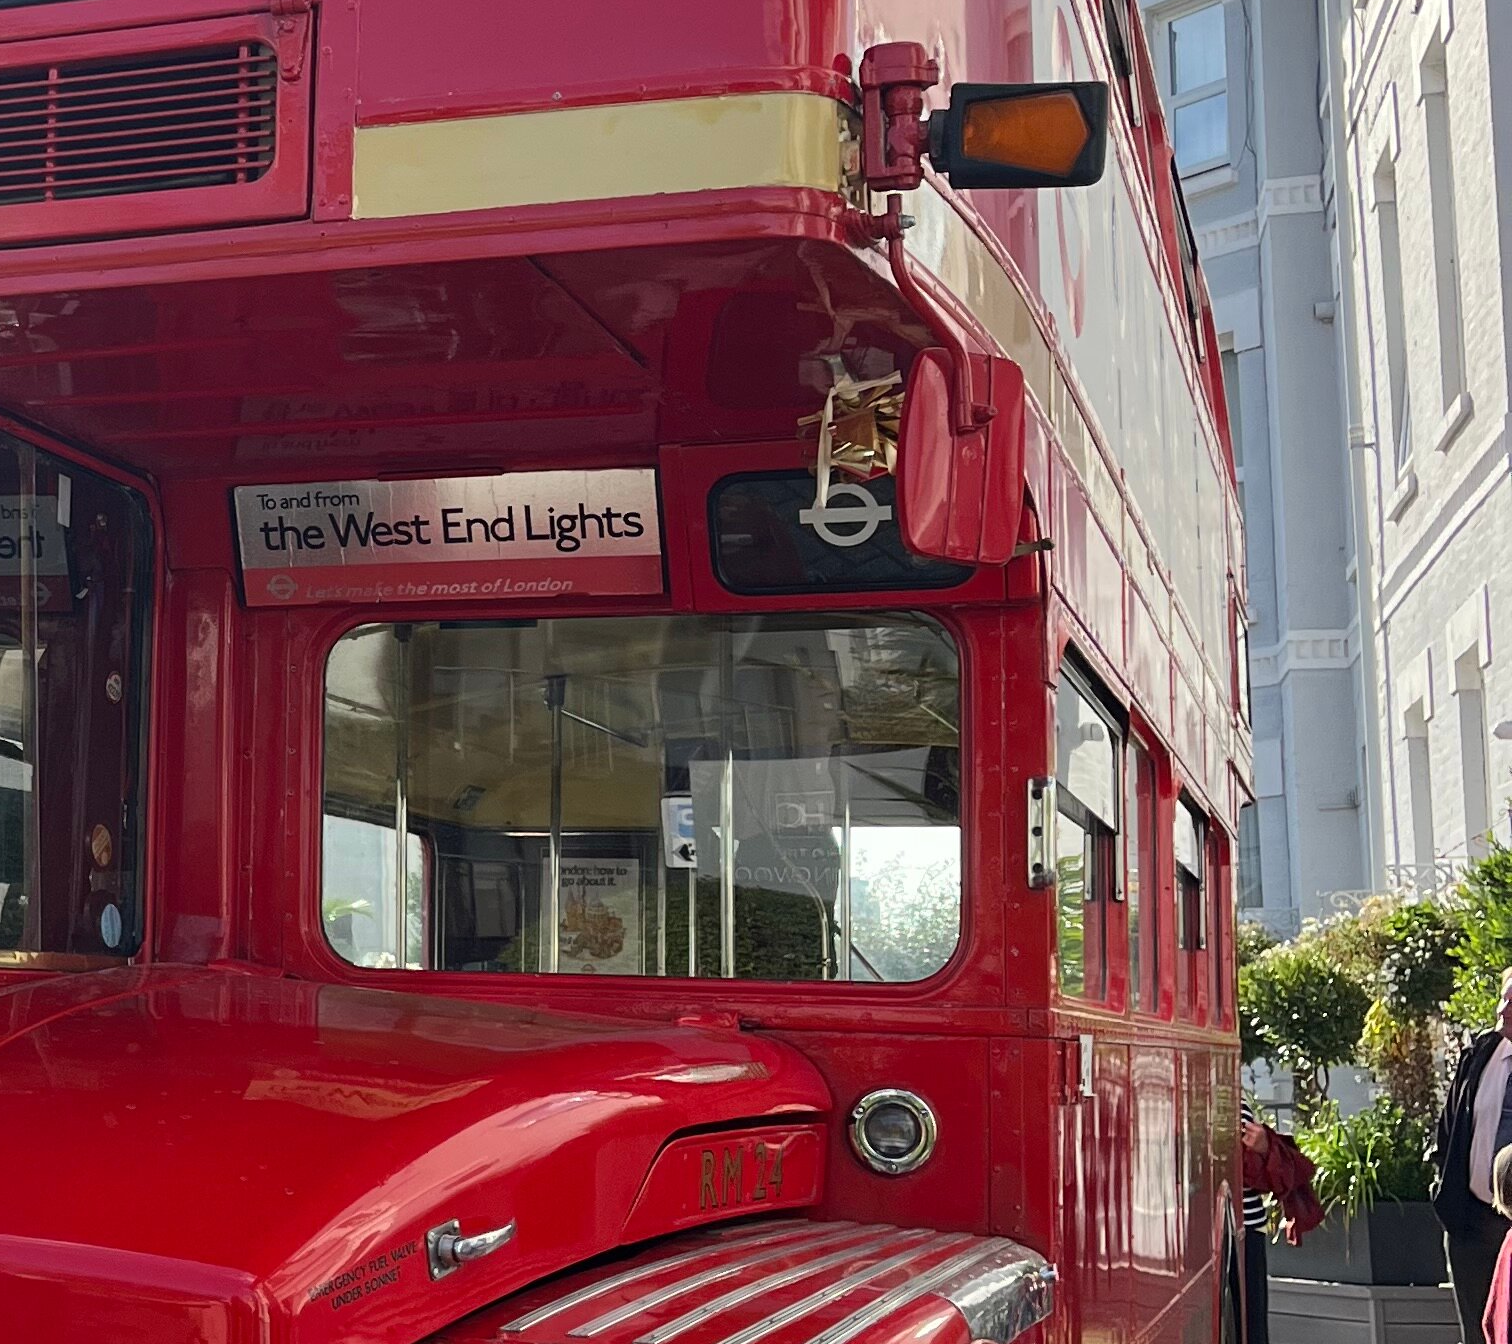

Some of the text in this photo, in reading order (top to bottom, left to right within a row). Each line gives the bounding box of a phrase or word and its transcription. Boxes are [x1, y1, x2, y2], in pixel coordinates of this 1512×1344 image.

[256, 490, 360, 511] To and from
[260, 502, 645, 553] the West End Lights
[397, 581, 426, 596] the
[430, 581, 477, 594] most
[481, 578, 500, 594] of
[503, 577, 574, 593] London
[699, 1142, 786, 1210] RM 24
[330, 1284, 364, 1311] UNDER
